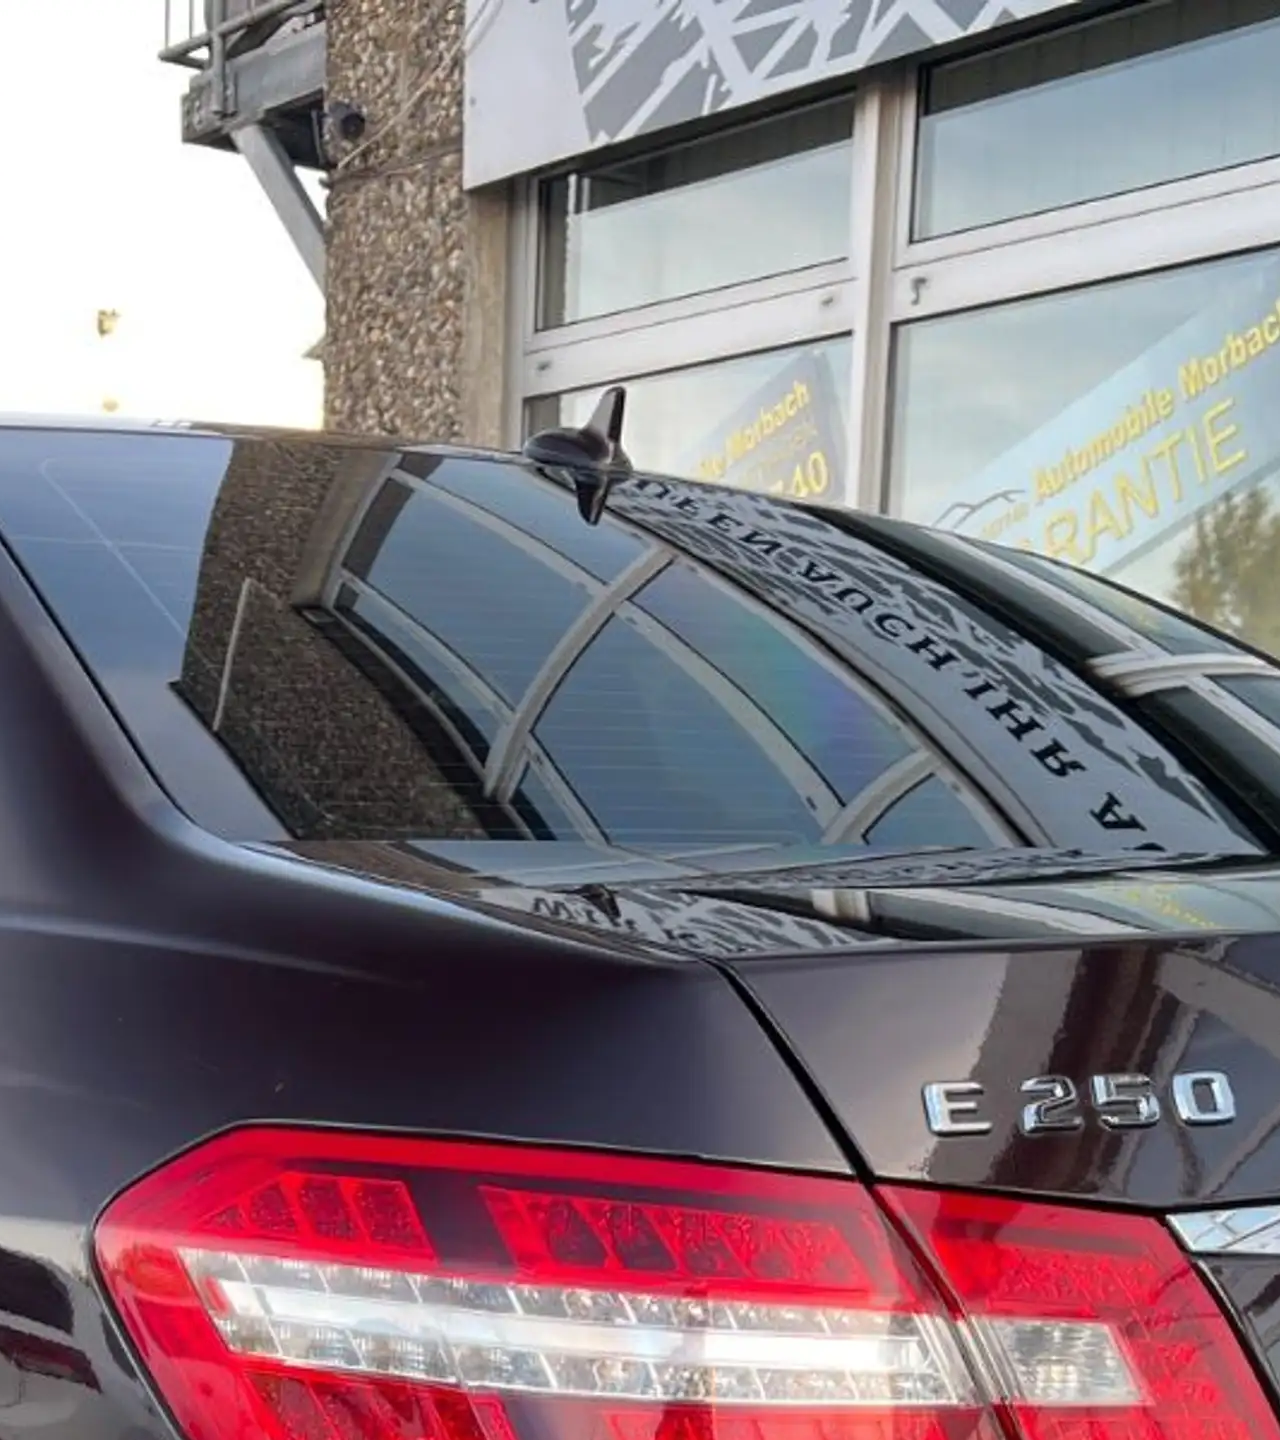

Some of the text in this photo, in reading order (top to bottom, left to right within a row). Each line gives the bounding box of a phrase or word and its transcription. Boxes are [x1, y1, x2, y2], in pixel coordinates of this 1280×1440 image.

[1016, 396, 1248, 564] RANTIE
[1033, 386, 1175, 500] Automobile
[921, 1070, 1237, 1137] E 250
